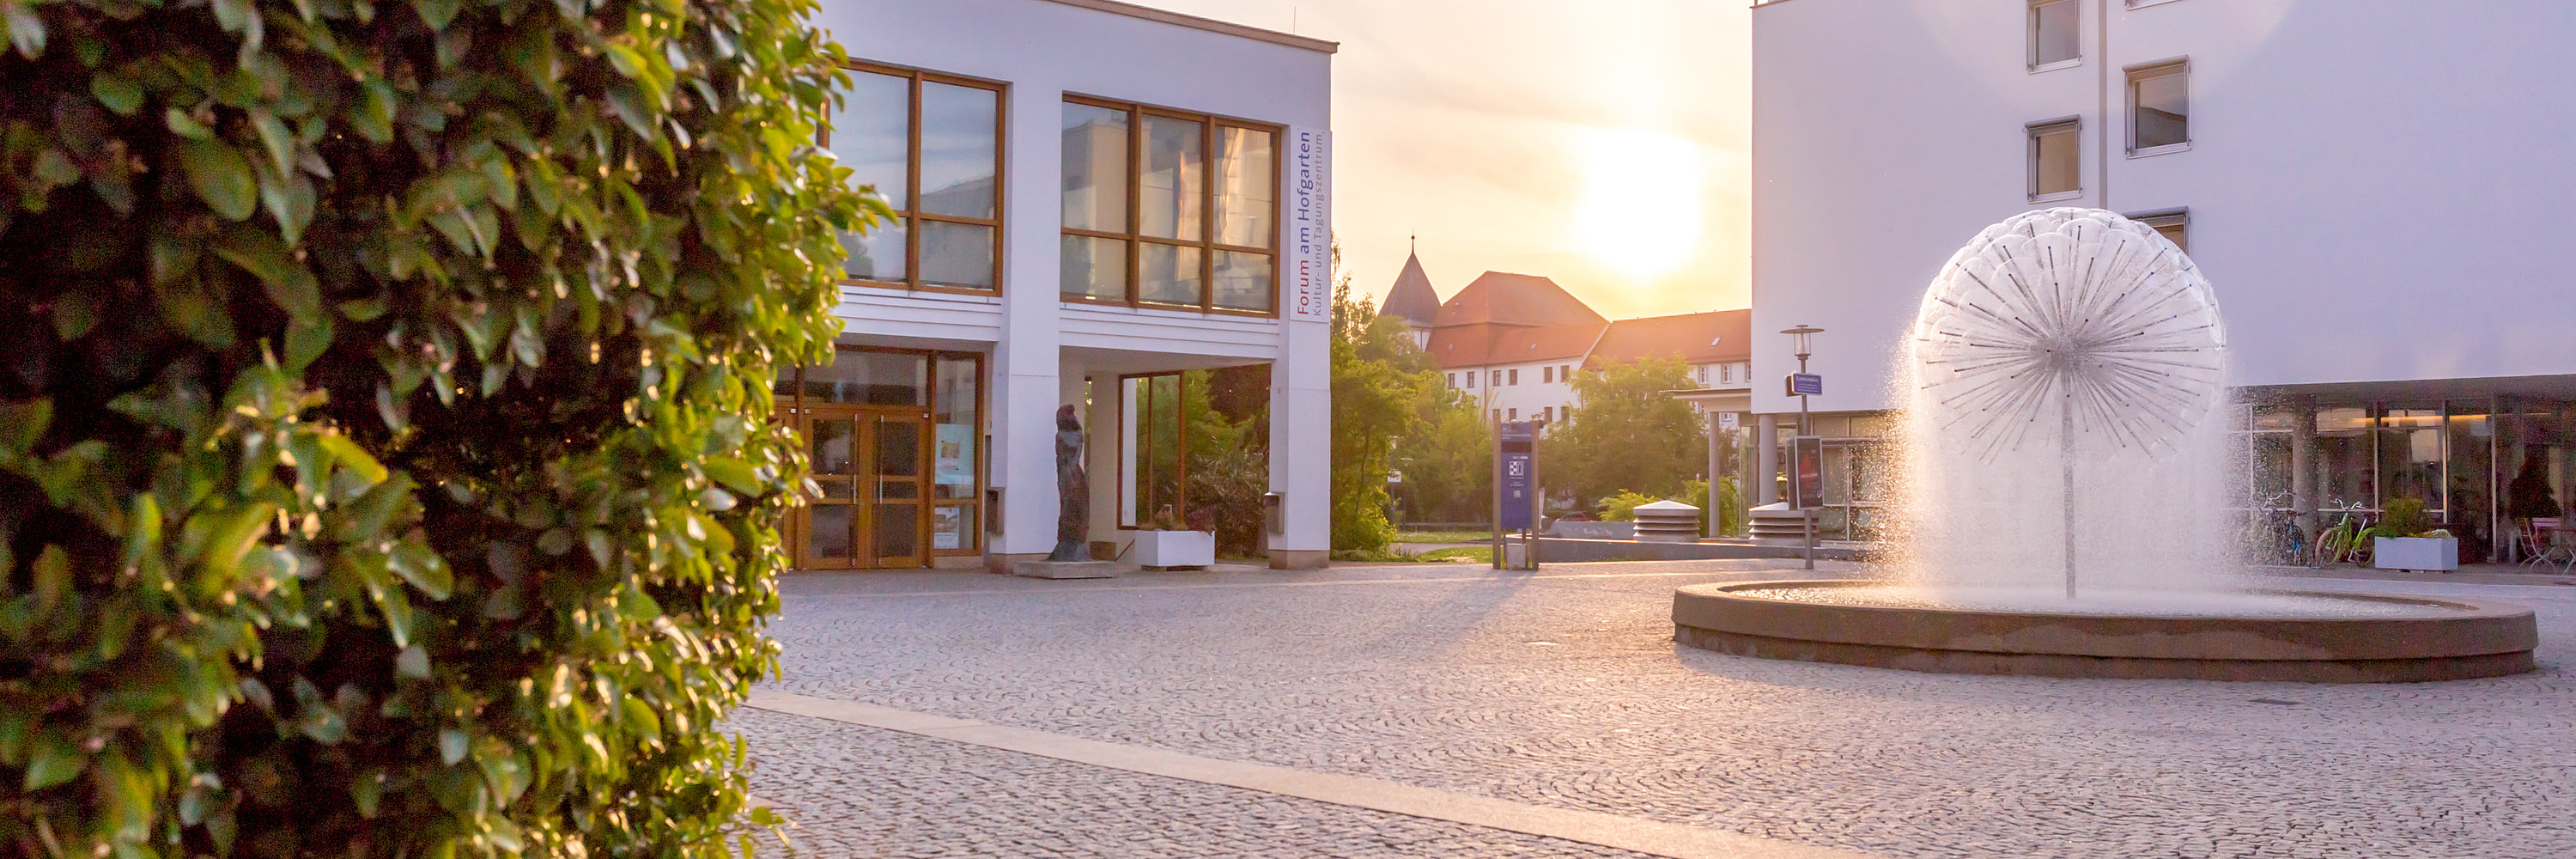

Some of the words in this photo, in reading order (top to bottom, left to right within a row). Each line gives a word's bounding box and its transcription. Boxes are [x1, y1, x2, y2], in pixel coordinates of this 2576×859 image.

[1297, 131, 1314, 221] Hofgarten
[1313, 133, 1325, 240] Tagungszentrum
[1300, 227, 1309, 254] am
[1313, 244, 1322, 268] und
[1297, 259, 1309, 314] Forum
[1313, 272, 1322, 317] Kultur-
